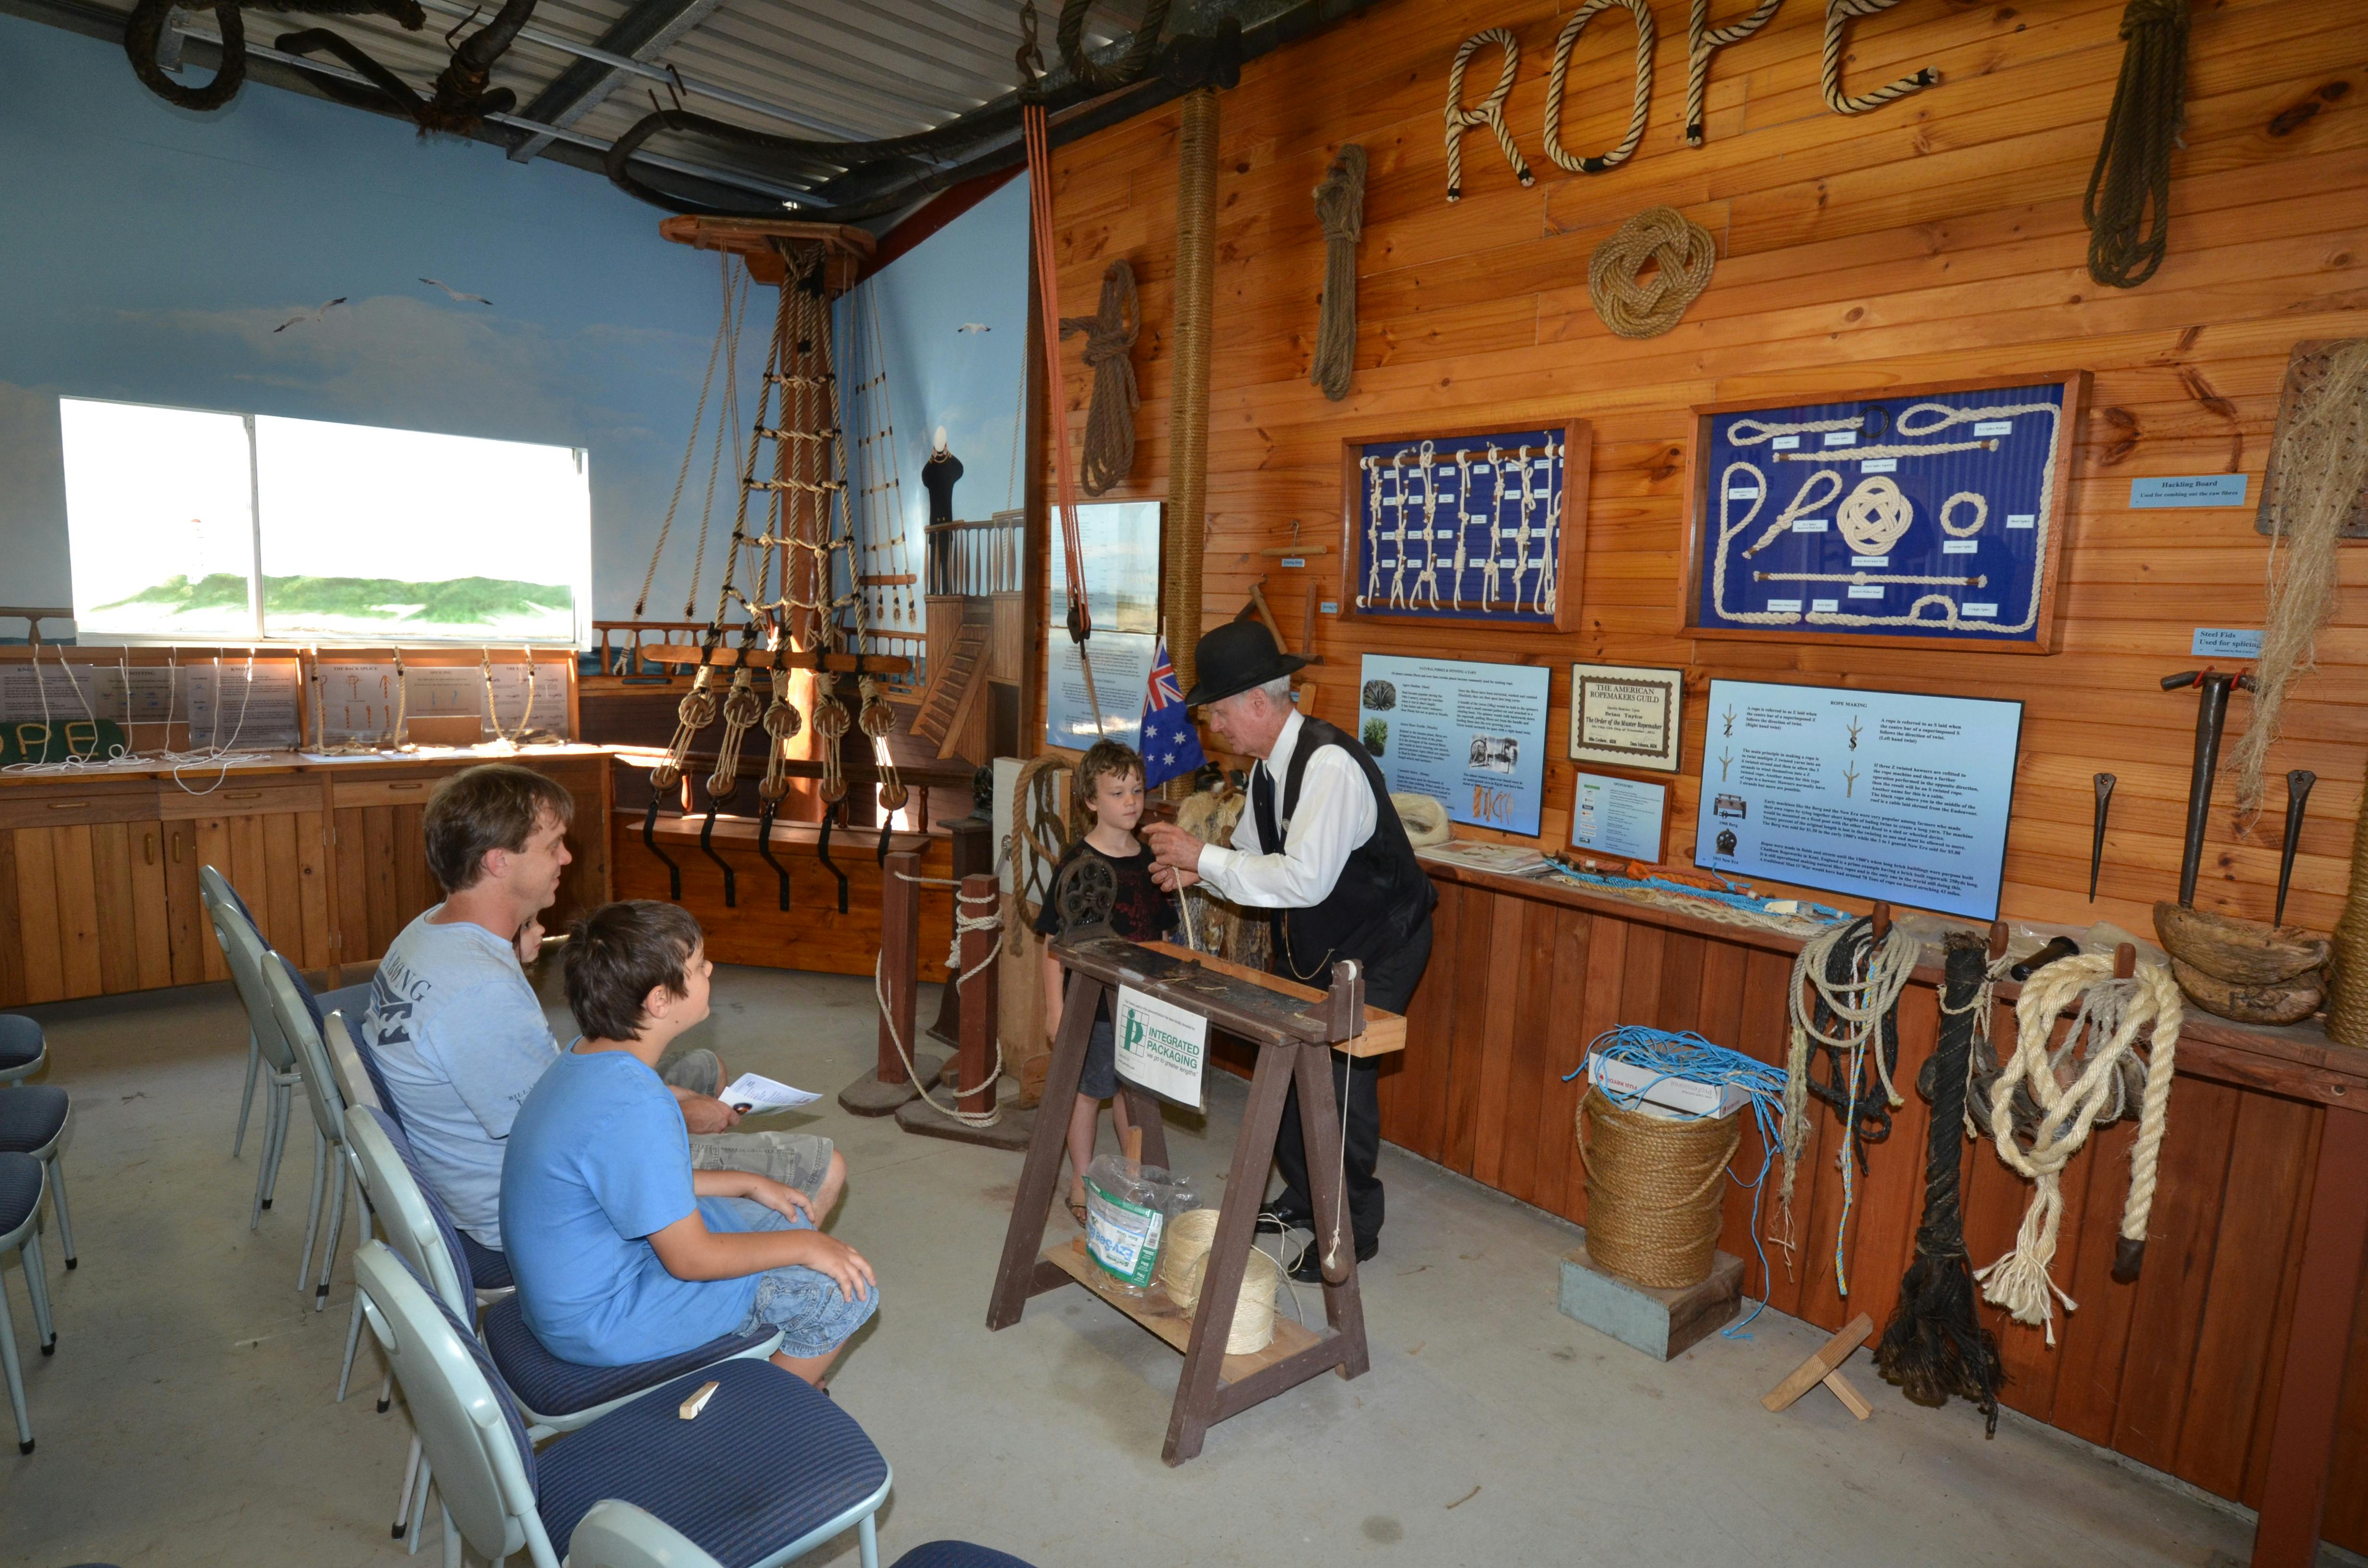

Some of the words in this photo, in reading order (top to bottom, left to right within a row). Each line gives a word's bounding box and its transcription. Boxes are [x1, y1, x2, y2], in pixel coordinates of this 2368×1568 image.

[1590, 691, 1635, 701] ROPEMAKERS
[1614, 686, 1654, 694] AMERICAN
[1723, 724, 1734, 737] Z
[1849, 736, 1857, 748] S
[1955, 784, 1979, 792] direction,
[1149, 1027, 1199, 1055] INTEGRATED
[1147, 1041, 1197, 1069] PACKAGING
[1165, 1060, 1179, 1069] greater
[1671, 1081, 1712, 1095] Professional
